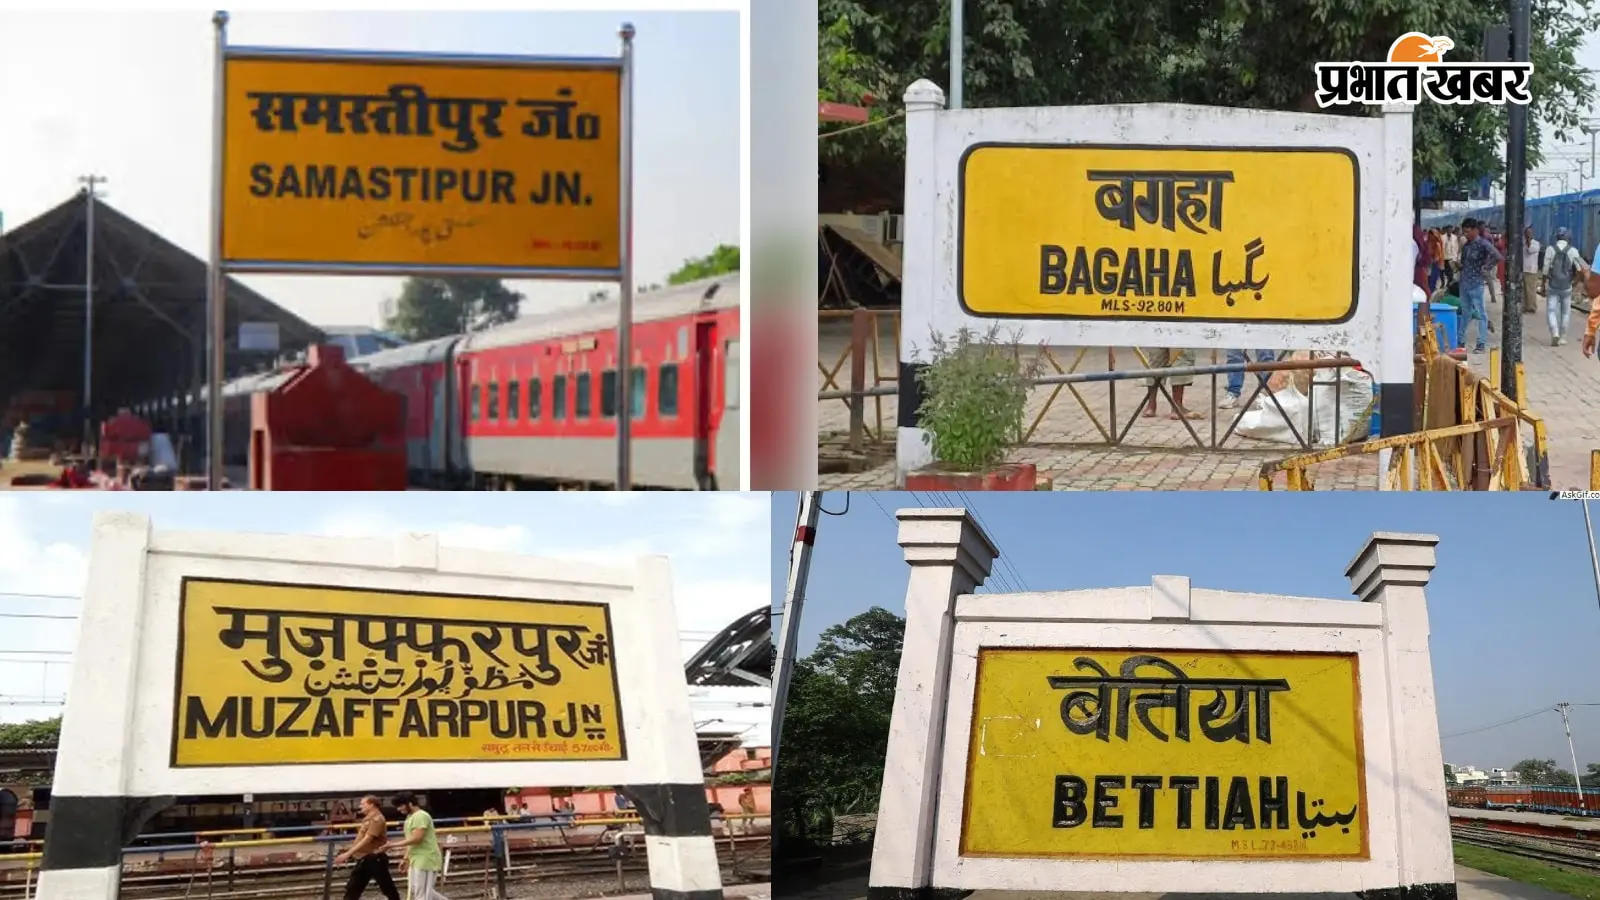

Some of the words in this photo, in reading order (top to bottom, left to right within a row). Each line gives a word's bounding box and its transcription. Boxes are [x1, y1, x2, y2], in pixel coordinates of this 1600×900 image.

[247, 84, 507, 152] समस्तीपुर
[249, 162, 516, 205] SAMASTIPUR
[529, 171, 593, 206] JN.
[1087, 169, 1235, 235] बगहा
[1040, 244, 1196, 297] BAGAHA
[184, 696, 546, 740] MUZAFFARPUR
[1046, 655, 1291, 744] बेतिया
[1052, 774, 1290, 830] BETTIAH
